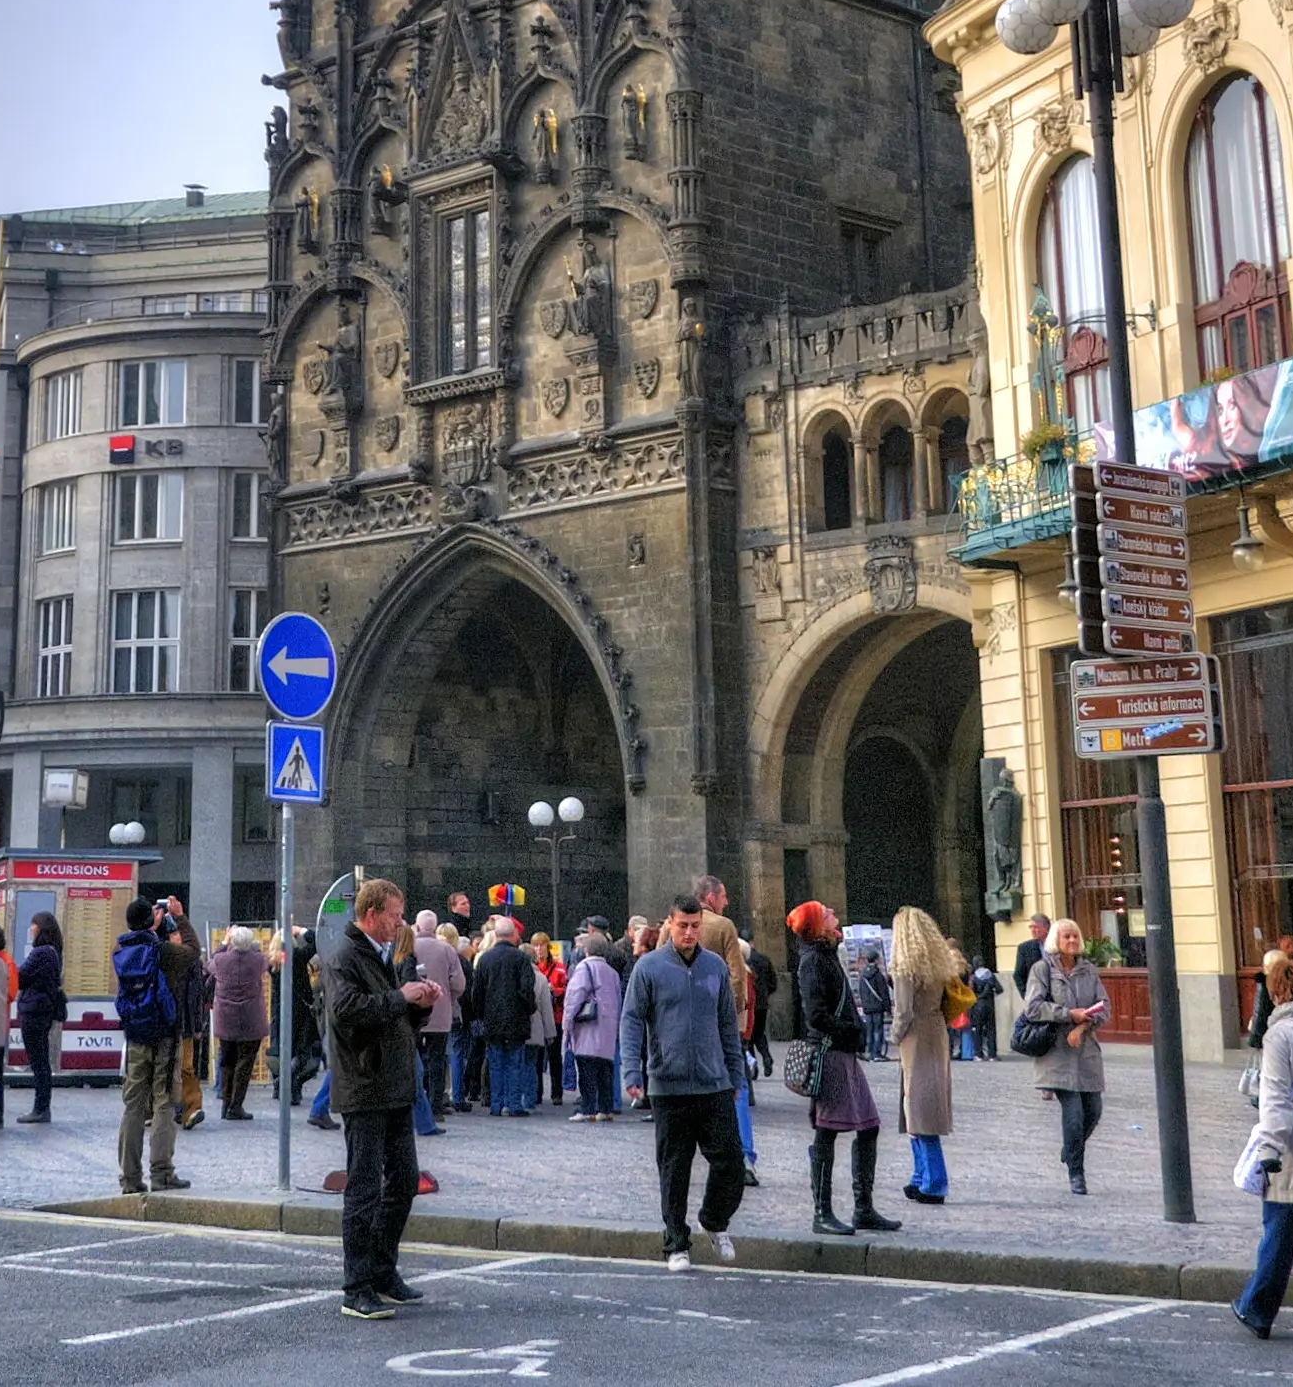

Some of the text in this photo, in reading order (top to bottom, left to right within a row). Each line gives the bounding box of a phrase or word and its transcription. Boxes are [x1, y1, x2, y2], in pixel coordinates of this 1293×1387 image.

[145, 439, 183, 456] KB
[1151, 569, 1172, 585] divadlo
[1122, 598, 1147, 618] Anežský
[1096, 668, 1130, 683] Muzeum
[1156, 663, 1179, 681] Prahy
[1116, 695, 1204, 715] Turistické informace
[1122, 731, 1152, 747] Metro
[36, 864, 110, 876] EXCURSIONS
[77, 1035, 113, 1047] TOUR
